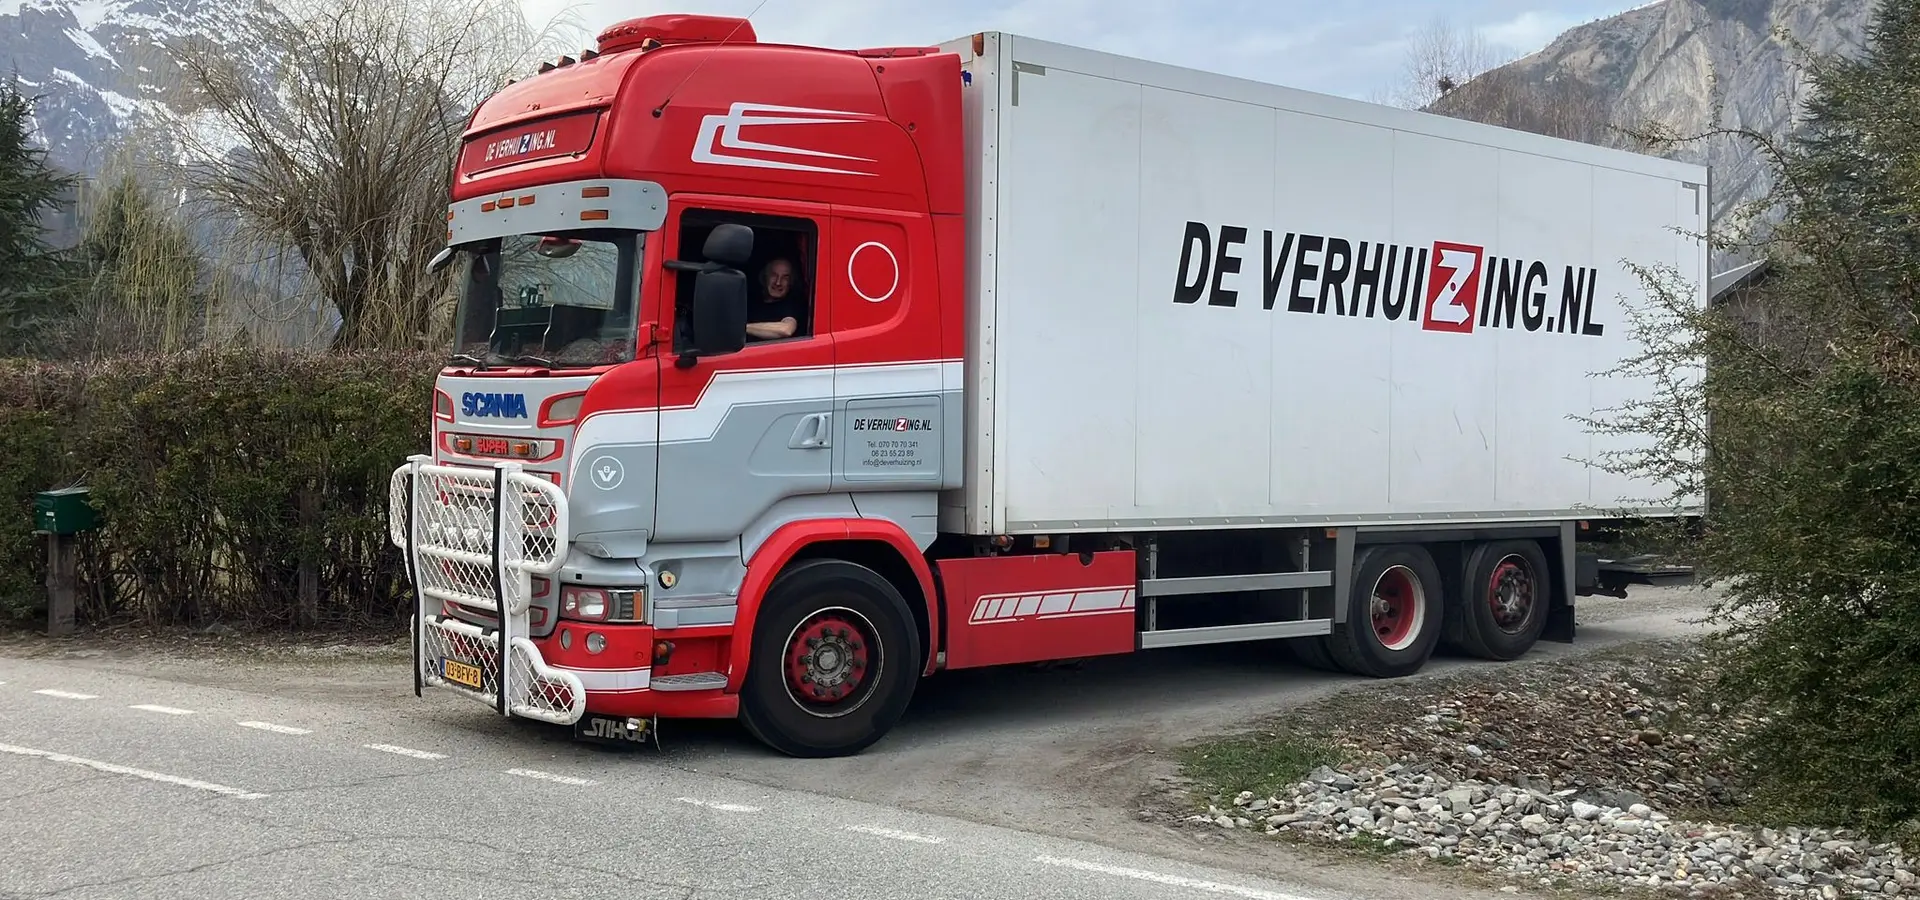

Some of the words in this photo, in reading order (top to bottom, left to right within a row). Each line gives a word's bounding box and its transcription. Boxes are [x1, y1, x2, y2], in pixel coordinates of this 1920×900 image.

[485, 143, 496, 162] DE
[496, 130, 556, 159] VERHUIZING.NL
[1173, 221, 1248, 308] DE
[1263, 230, 1604, 336] VERHUIZING.NL
[461, 392, 528, 419] SCANIA
[854, 419, 866, 431] DE
[867, 418, 932, 432] VERHUIZING.NL
[476, 439, 509, 455] SUPER
[862, 459, 922, 467] info@deverhuizing.nl
